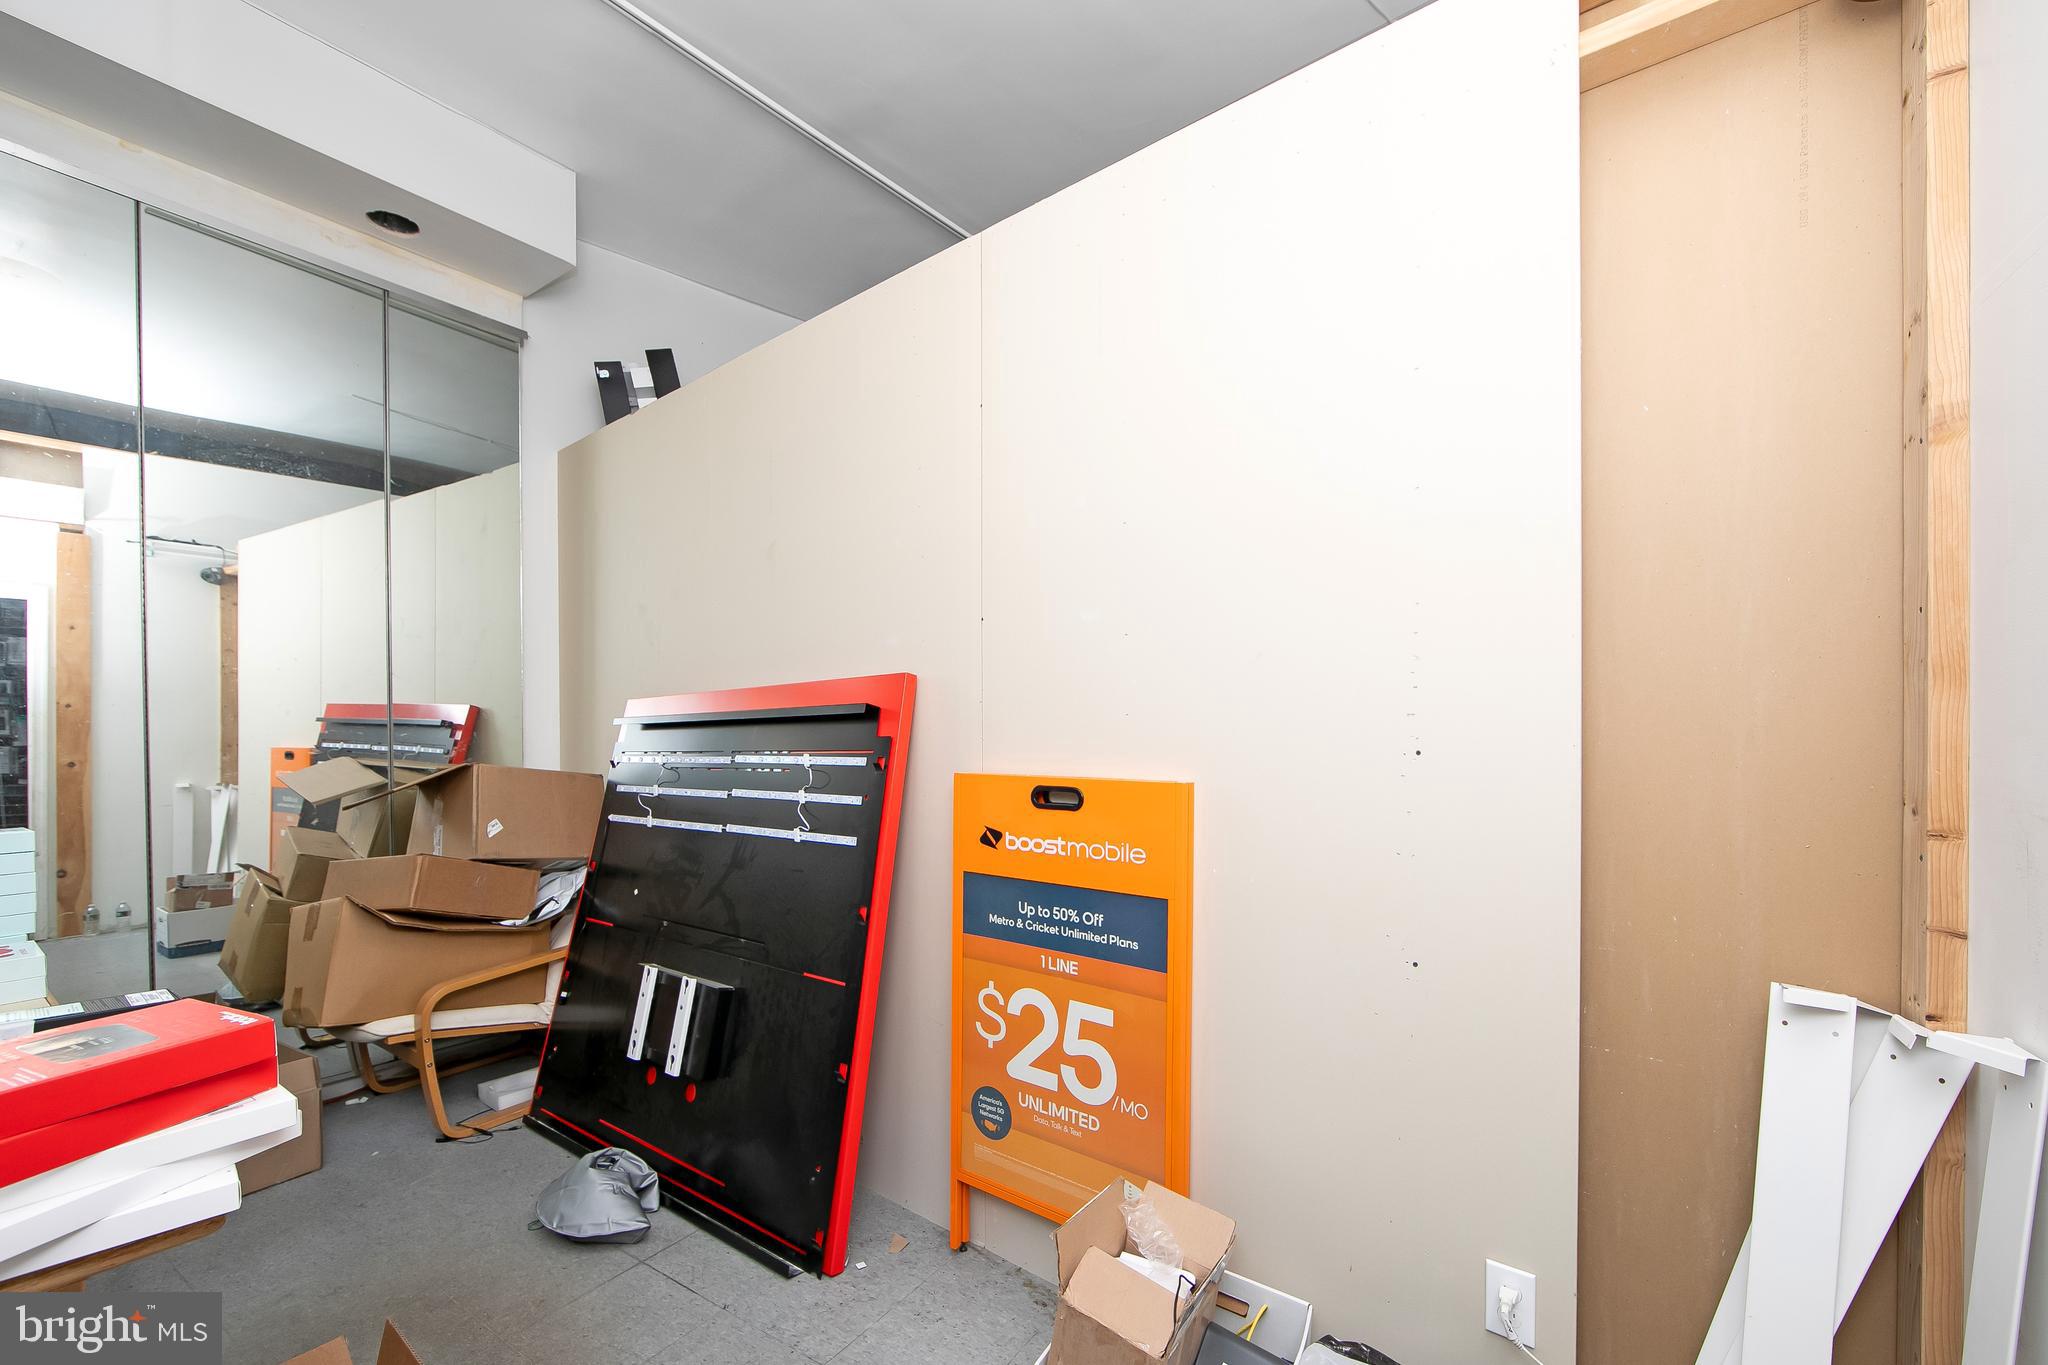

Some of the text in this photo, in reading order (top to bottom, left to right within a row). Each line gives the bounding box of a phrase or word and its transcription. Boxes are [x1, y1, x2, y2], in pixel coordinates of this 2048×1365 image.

[1018, 901, 1104, 928] Up to 50% Off
[989, 913, 1139, 950] Metro & Cricket Unlimited Plans
[1040, 955, 1079, 975] 1 LINE
[977, 1101, 1005, 1115] Largest 5G
[979, 1094, 1003, 1107] America's
[979, 1109, 1003, 1122] Networks
[1018, 1091, 1101, 1132] UNLIMITED
[1050, 1120, 1063, 1130] Talk
[1063, 1125, 1069, 1133] &
[1069, 1127, 1083, 1138] Text
